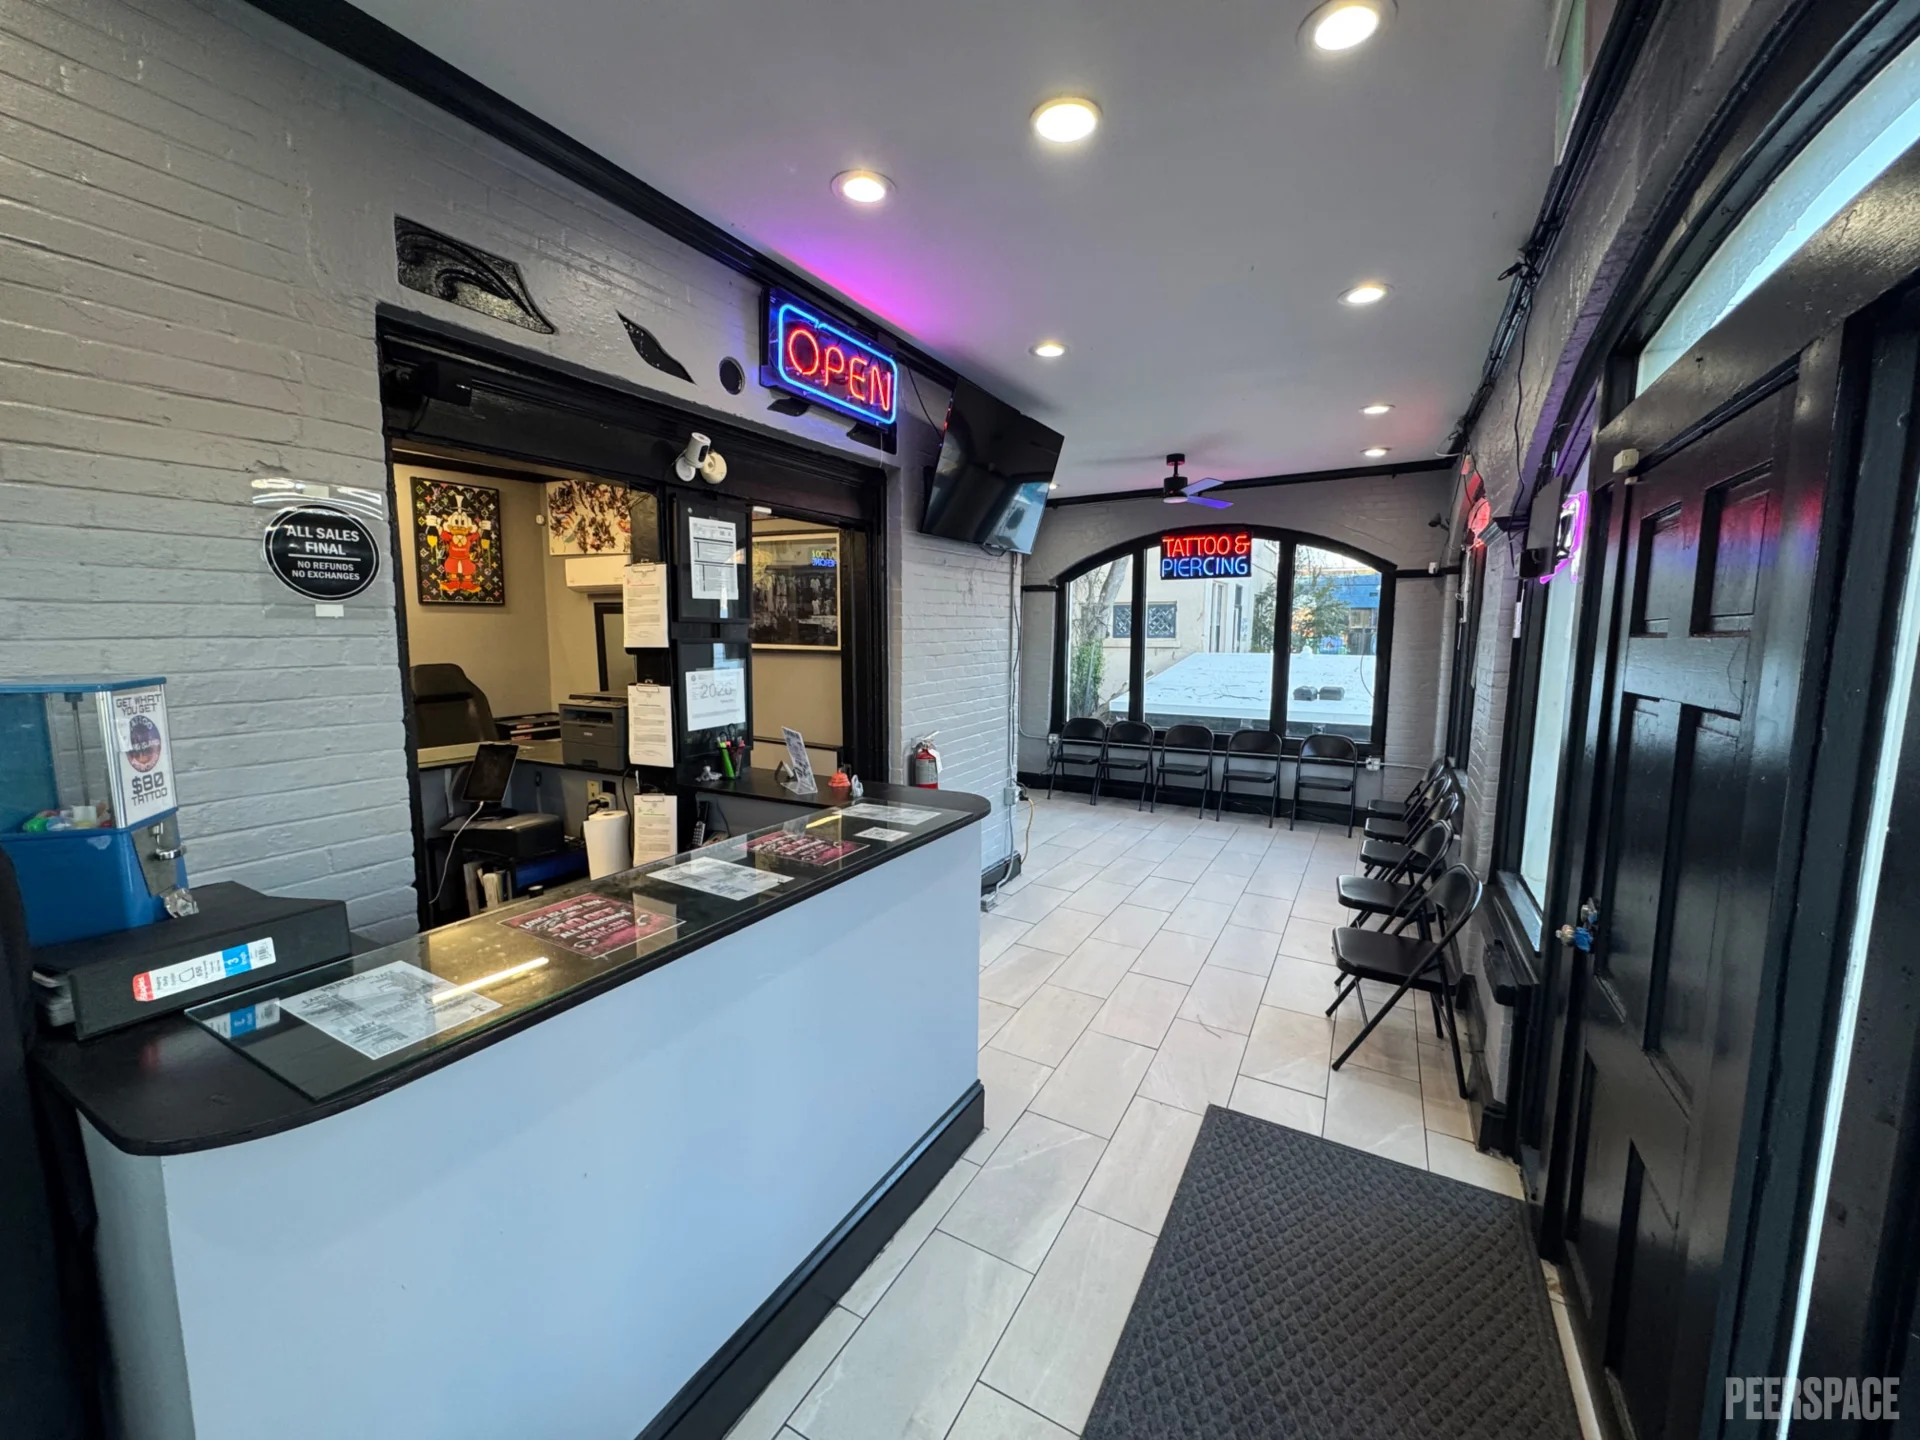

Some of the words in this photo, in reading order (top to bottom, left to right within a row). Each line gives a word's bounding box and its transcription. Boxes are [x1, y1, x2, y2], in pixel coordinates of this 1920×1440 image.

[788, 328, 891, 412] OPEN
[286, 525, 313, 538] ALL
[316, 527, 359, 542] SALES
[304, 541, 346, 555] FINAL
[1162, 535, 1231, 558] TATTOO
[1234, 534, 1251, 555] &
[297, 560, 310, 569] NO
[312, 561, 353, 570] REFUNDS
[1161, 556, 1247, 577] PIERCING
[291, 569, 305, 578] NO
[307, 570, 360, 580] EXCHANGES
[115, 697, 132, 707] GET
[134, 693, 161, 704] WHAT
[121, 706, 137, 716] YOU
[138, 702, 157, 714] GET
[131, 770, 164, 795] $80
[131, 787, 167, 806] TATTOO
[519, 915, 547, 929] LONG
[547, 903, 582, 918] ISLAND
[559, 926, 581, 938] ALL
[227, 956, 238, 965] 3
